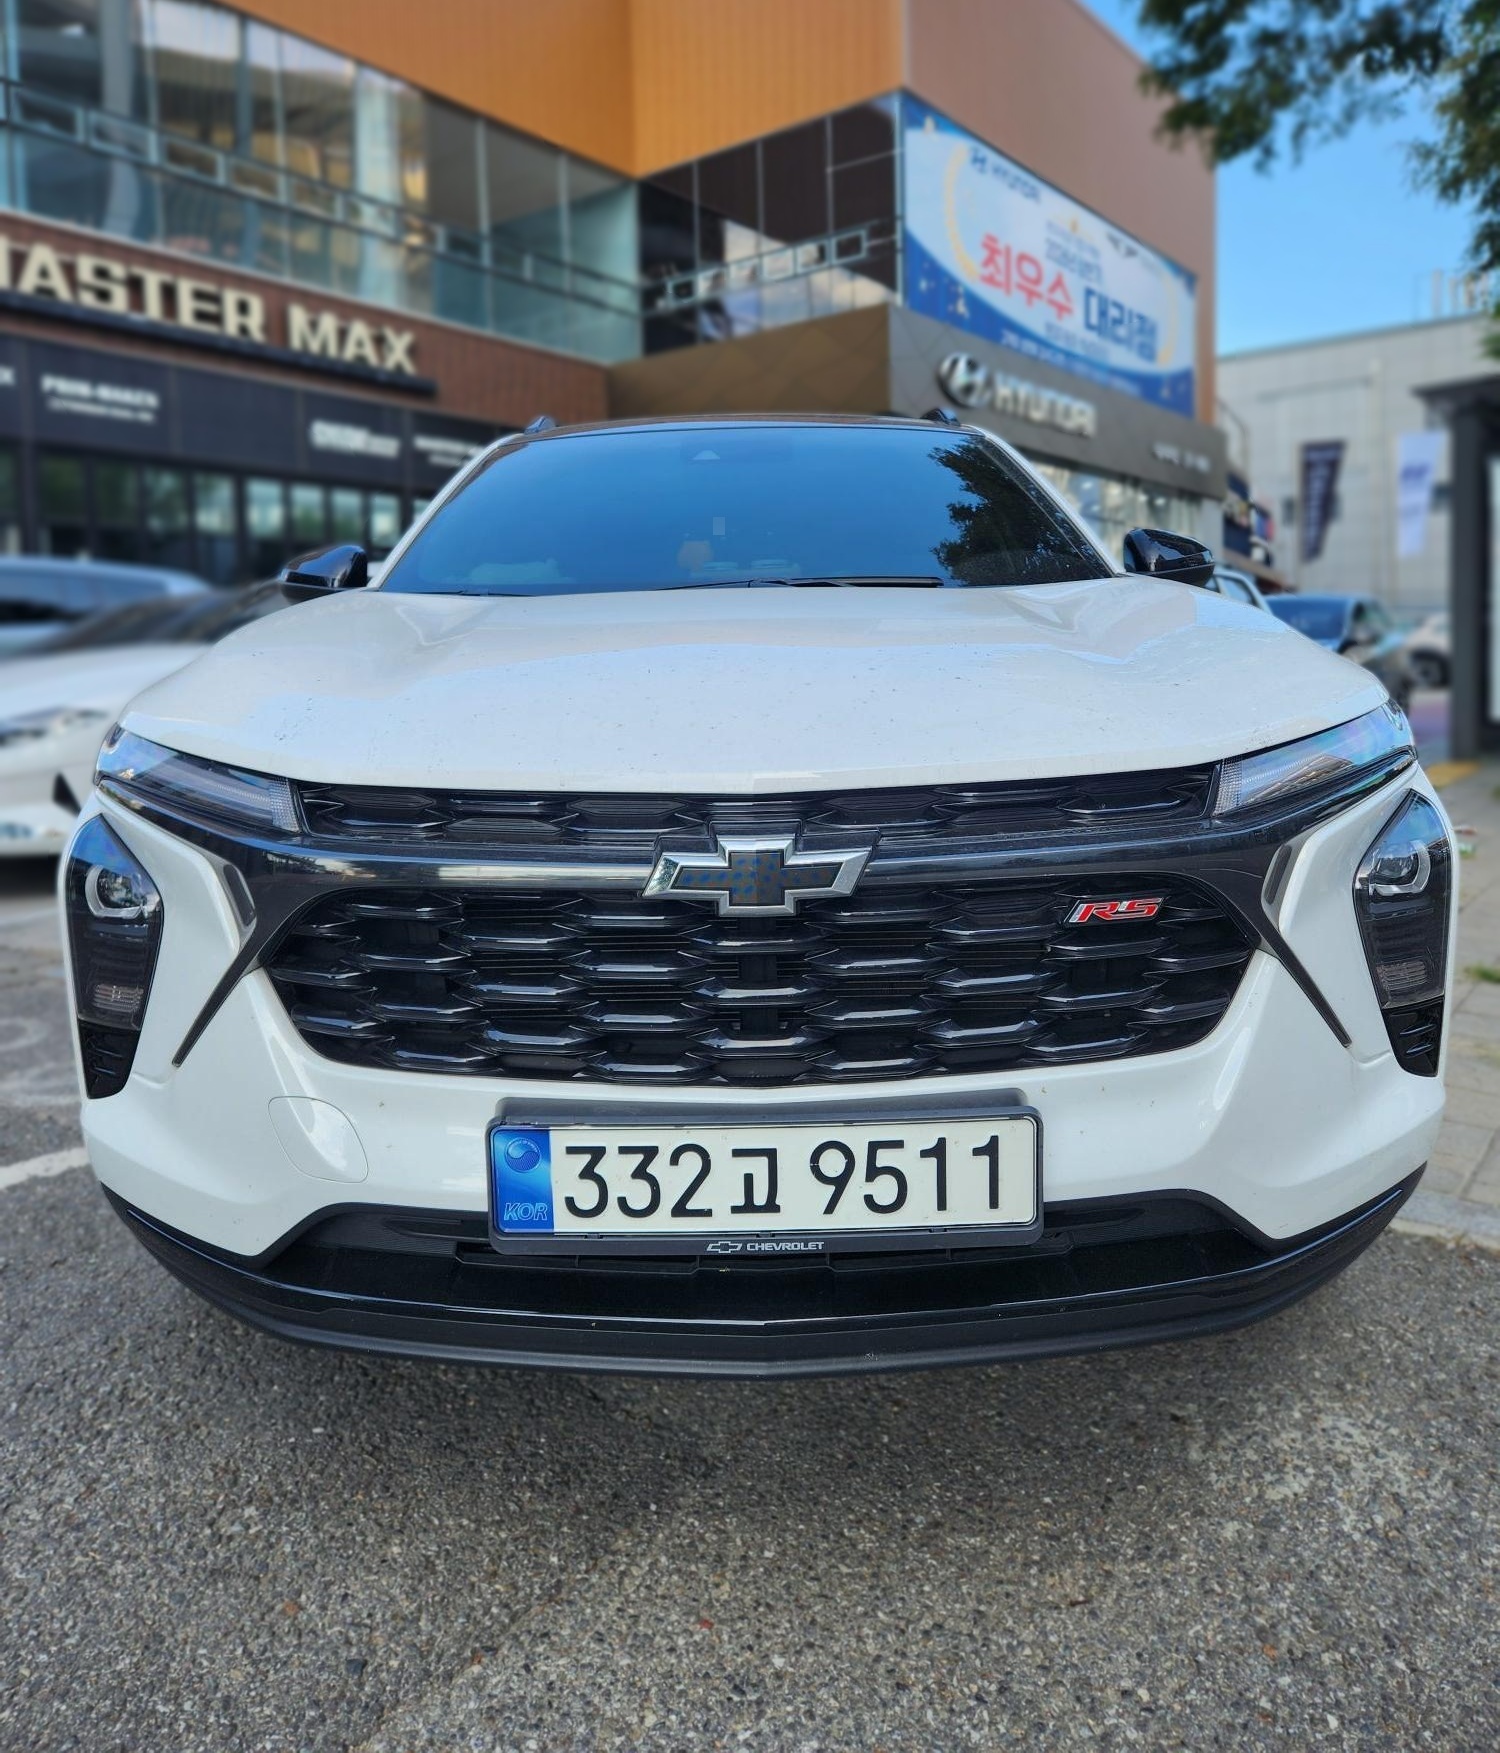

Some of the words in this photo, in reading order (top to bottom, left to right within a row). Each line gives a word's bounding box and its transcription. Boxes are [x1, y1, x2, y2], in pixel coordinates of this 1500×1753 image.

[978, 233, 1074, 320] 최우수
[1084, 286, 1159, 365] 대리점
[288, 304, 416, 375] MAX
[1068, 897, 1162, 922] RS
[564, 1143, 781, 1219] 332고
[809, 1134, 999, 1216] 9511
[503, 1202, 548, 1221] KOR
[746, 1241, 825, 1251] CHEVROLET
